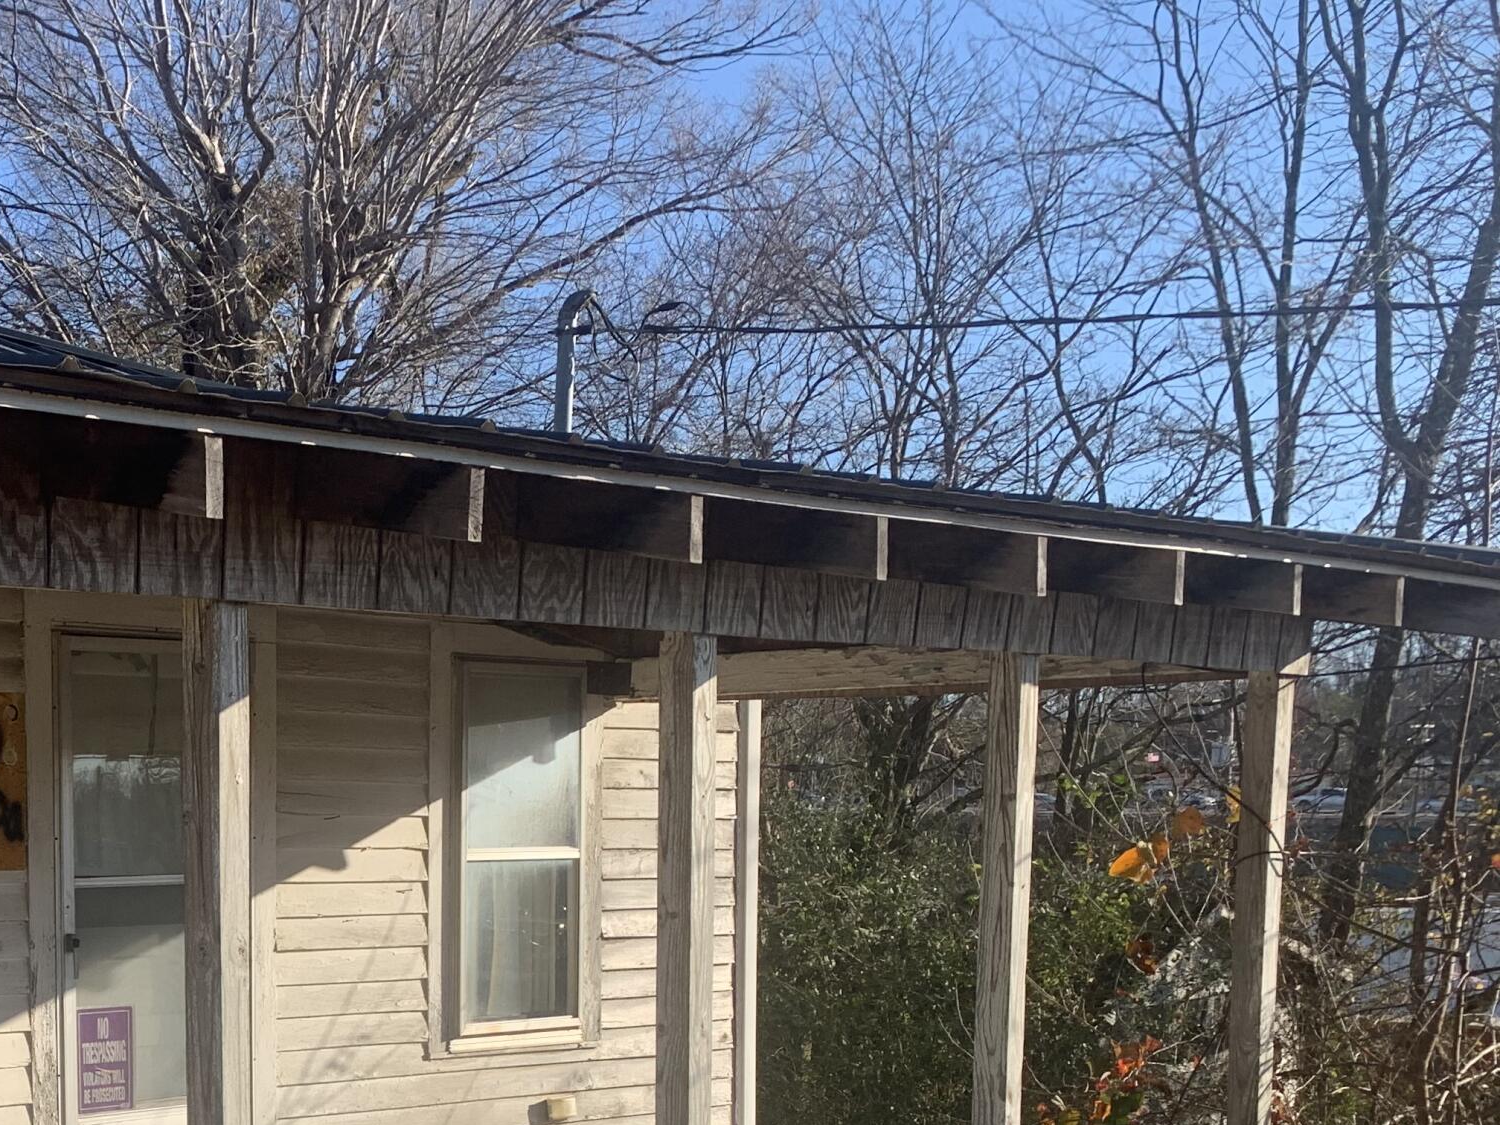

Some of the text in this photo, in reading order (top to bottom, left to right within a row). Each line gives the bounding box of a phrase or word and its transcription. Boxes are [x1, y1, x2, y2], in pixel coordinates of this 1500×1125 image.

[97, 1017, 109, 1040] NO
[82, 1040, 127, 1065] TRESPASSING
[83, 1088, 92, 1105] BE
